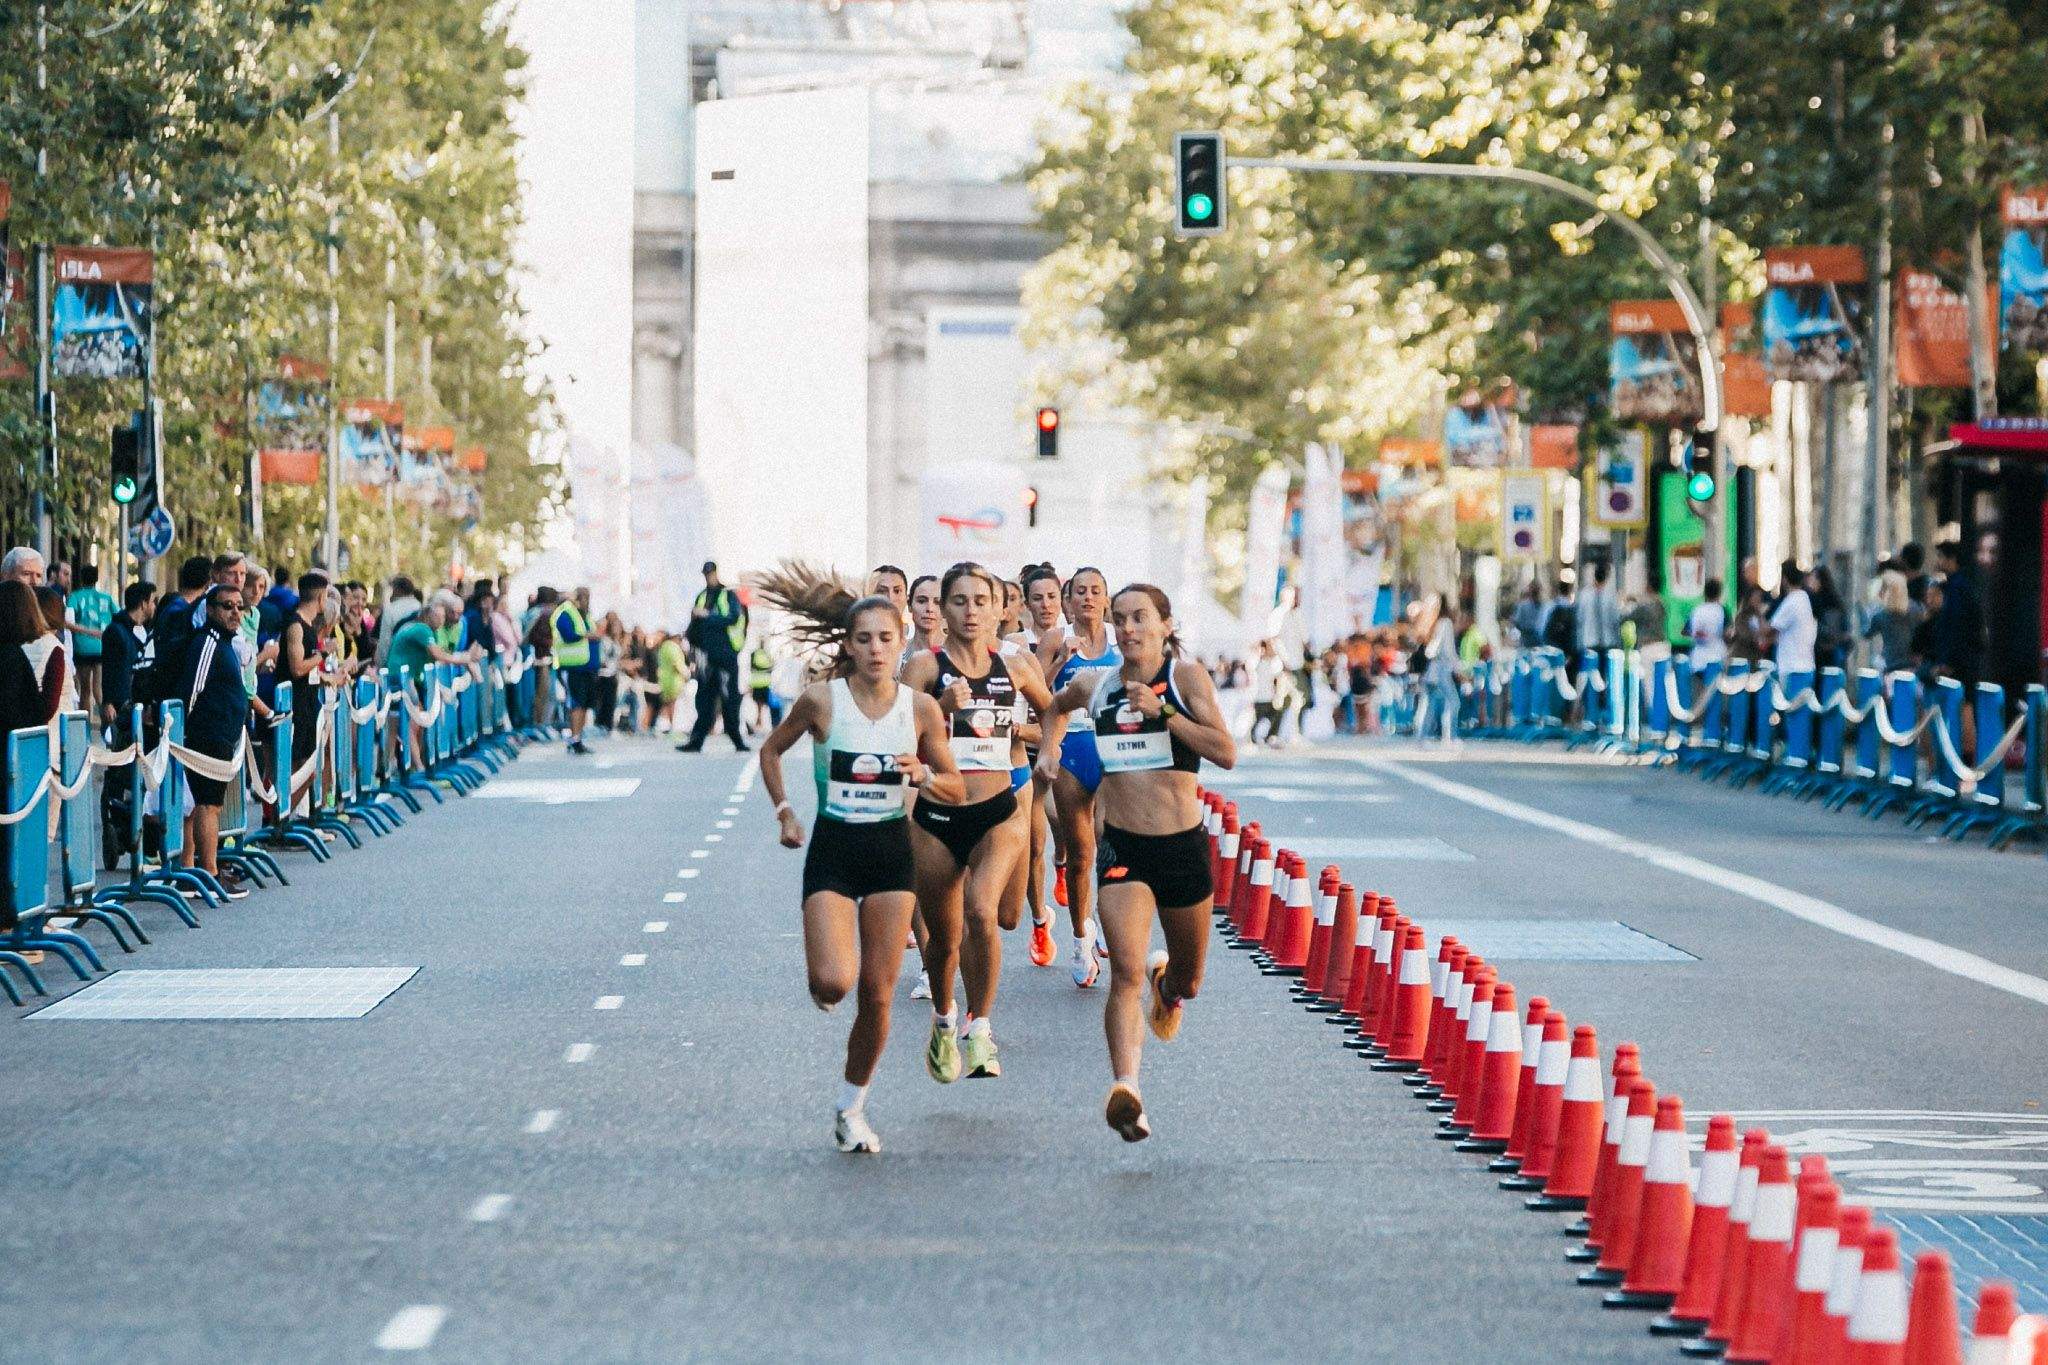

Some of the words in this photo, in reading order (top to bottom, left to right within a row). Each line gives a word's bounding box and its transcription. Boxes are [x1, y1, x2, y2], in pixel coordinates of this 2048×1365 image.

[2009, 196, 2048, 219] ISL
[61, 260, 102, 280] ISLA
[1769, 262, 1814, 281] ISLA
